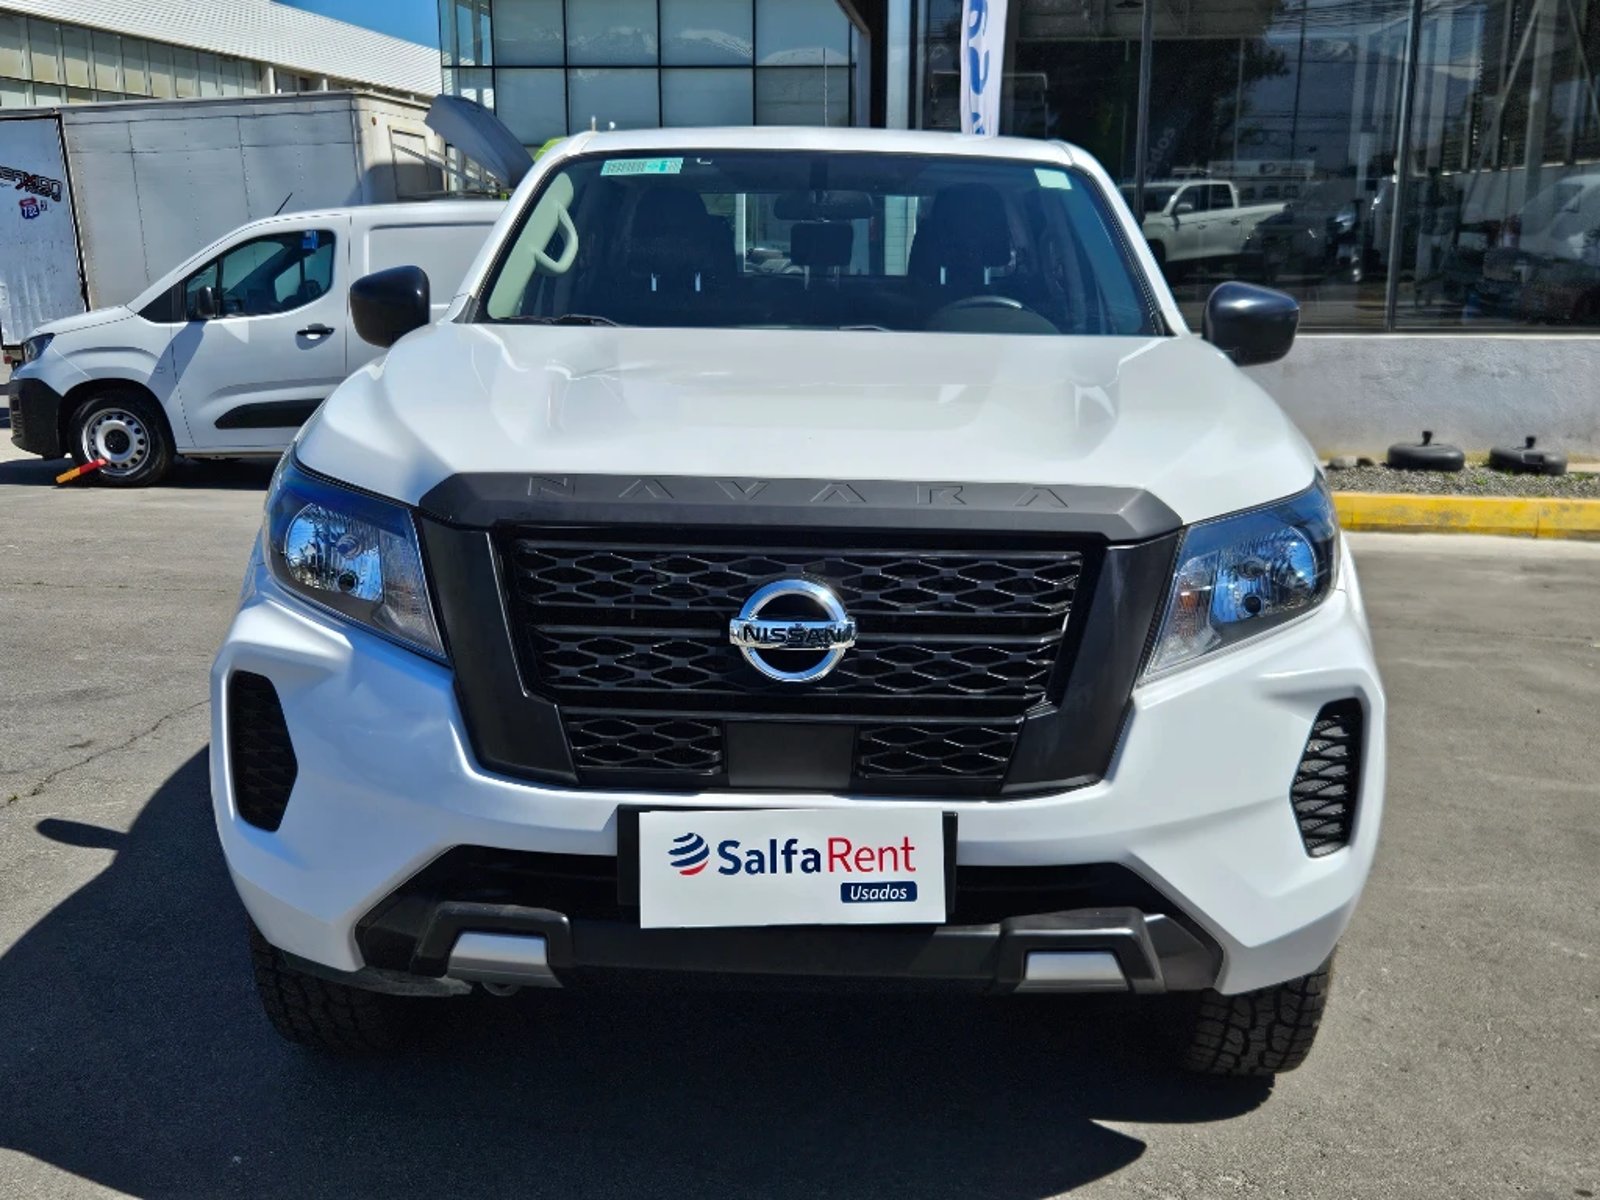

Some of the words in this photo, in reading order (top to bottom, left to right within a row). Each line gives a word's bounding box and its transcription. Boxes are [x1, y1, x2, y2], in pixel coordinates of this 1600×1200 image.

[527, 475, 1069, 508] NAVARA
[743, 625, 842, 643] NISSAN
[718, 836, 916, 875] SalfaRent
[850, 885, 907, 900] Usados
